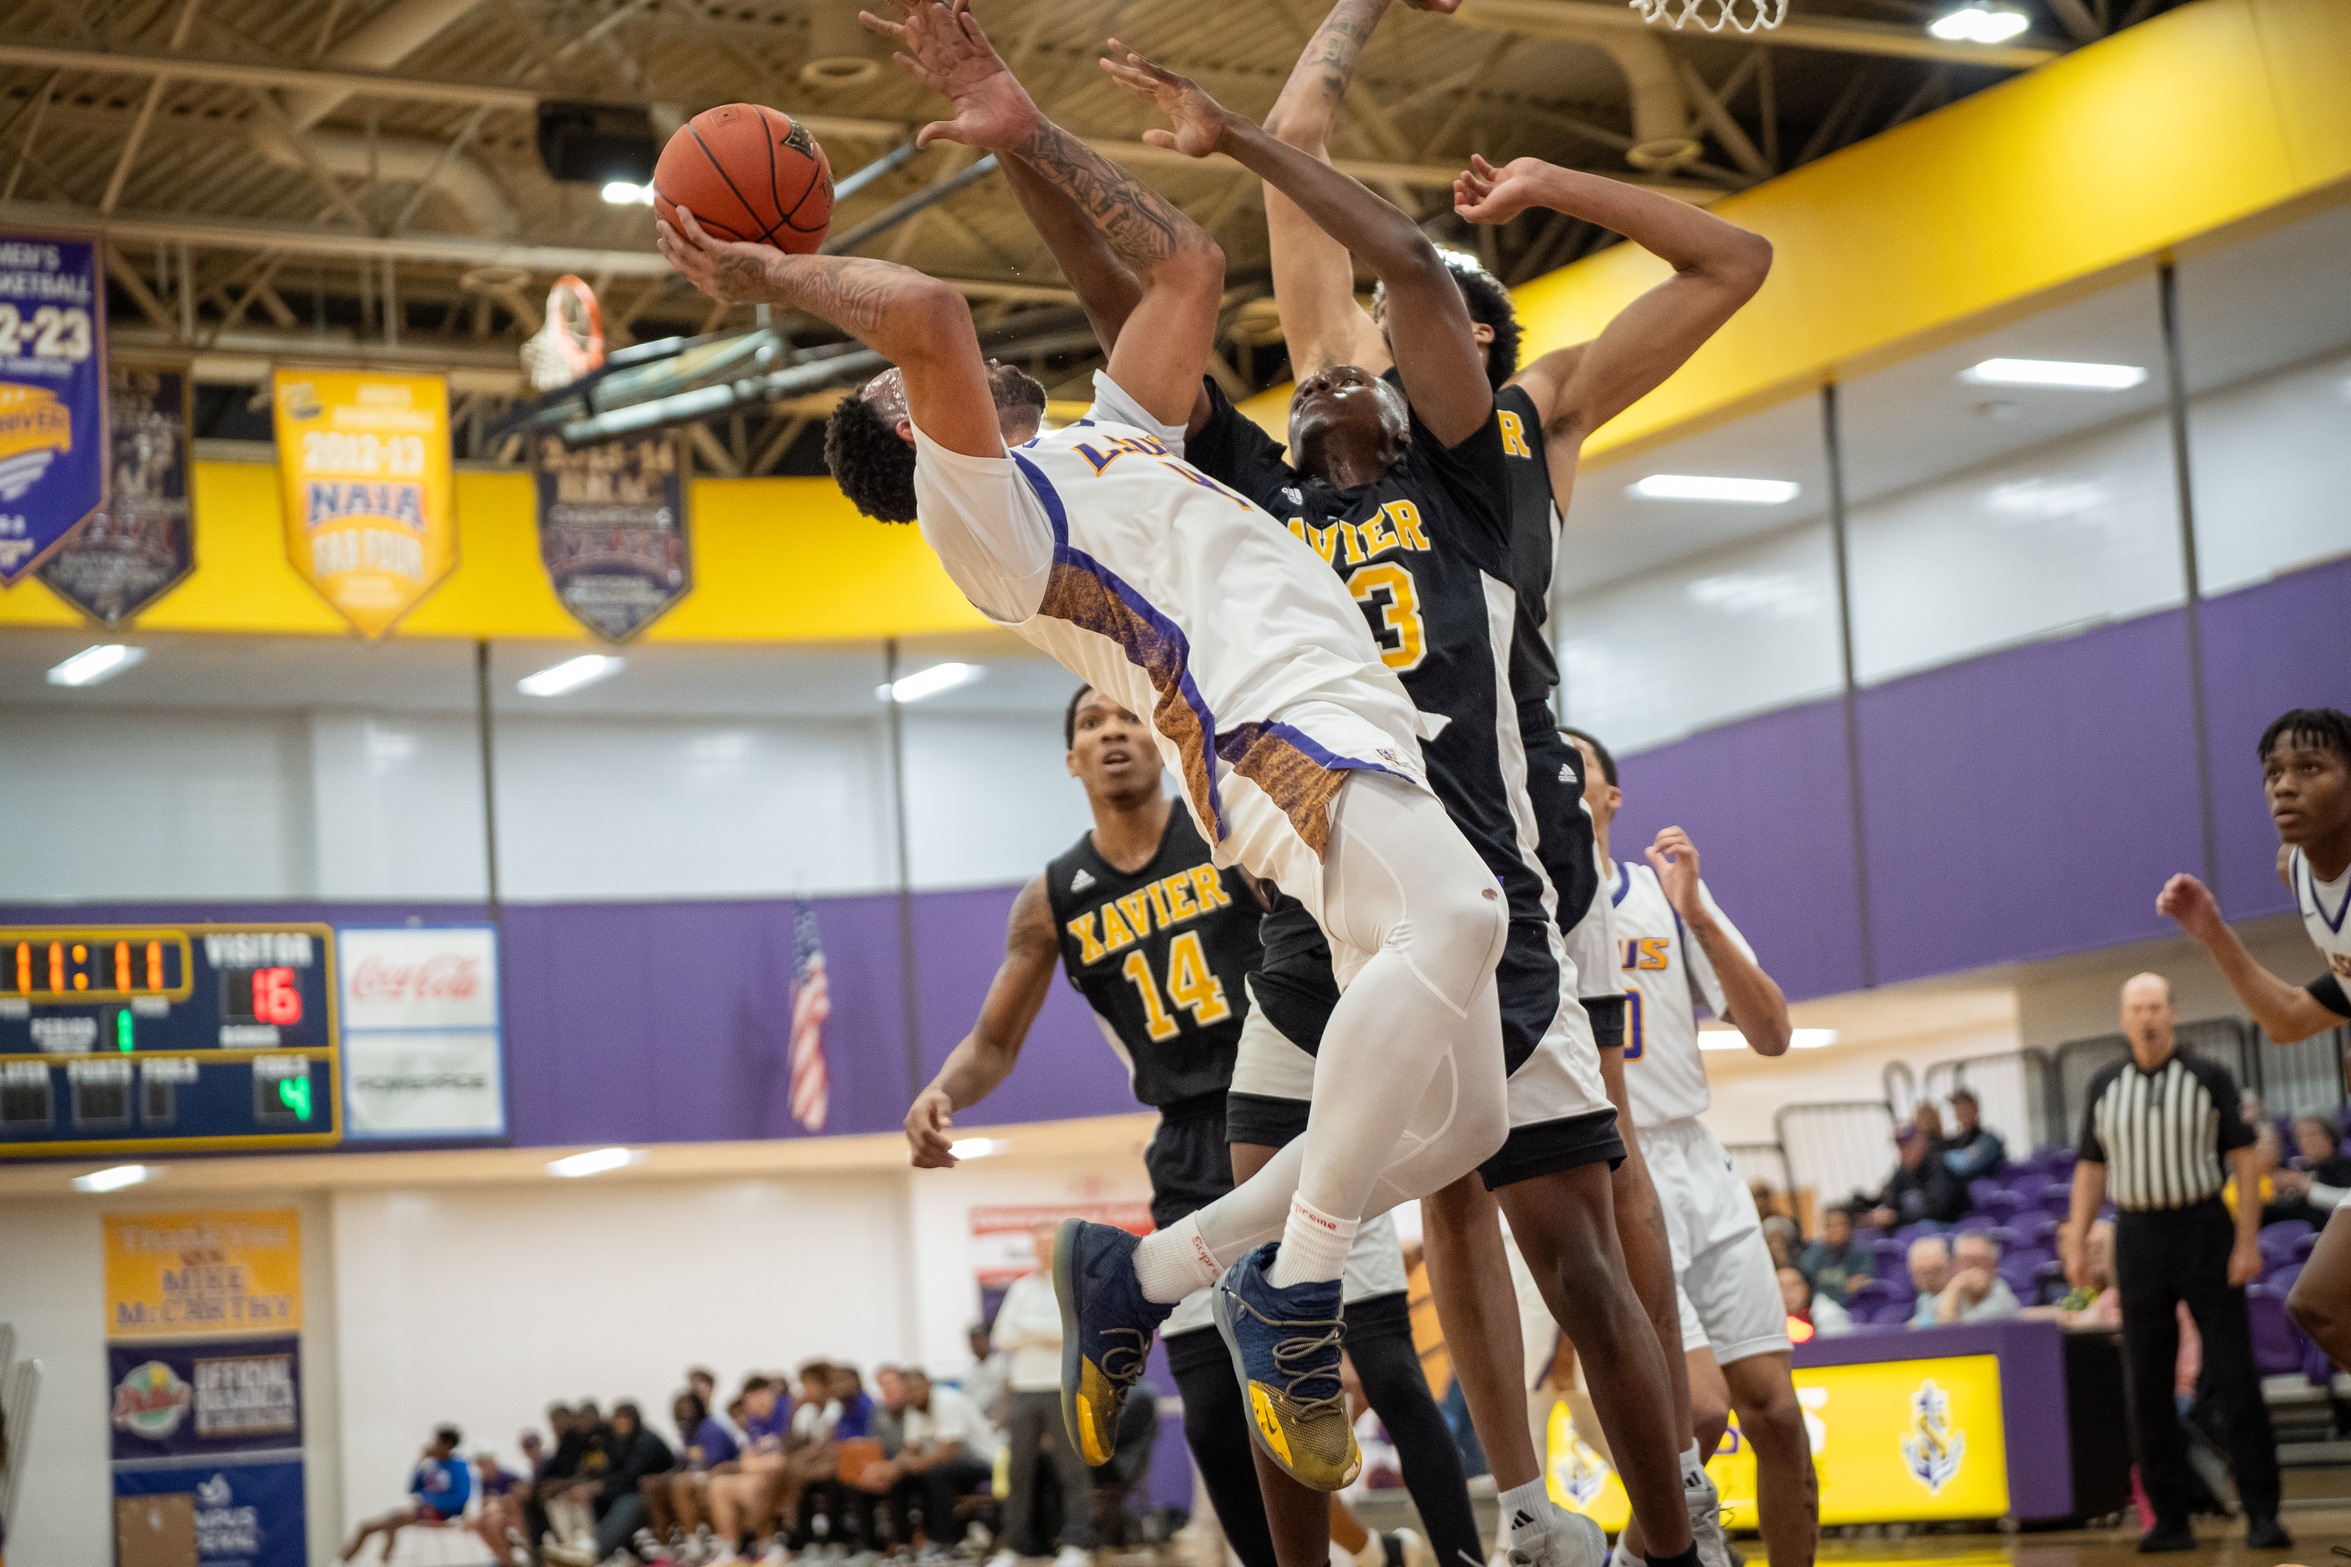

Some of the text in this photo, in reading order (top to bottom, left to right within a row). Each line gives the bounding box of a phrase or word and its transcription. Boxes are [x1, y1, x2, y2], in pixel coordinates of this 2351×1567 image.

[0, 271, 90, 303] KETBALL
[304, 430, 424, 475] 2012-13
[308, 481, 426, 534] NAIA
[1067, 863, 1232, 965] XAVIER
[16, 940, 163, 995] 11:11
[205, 933, 313, 966] VISITOR
[252, 967, 303, 1025] 16
[1122, 930, 1232, 1043] 14
